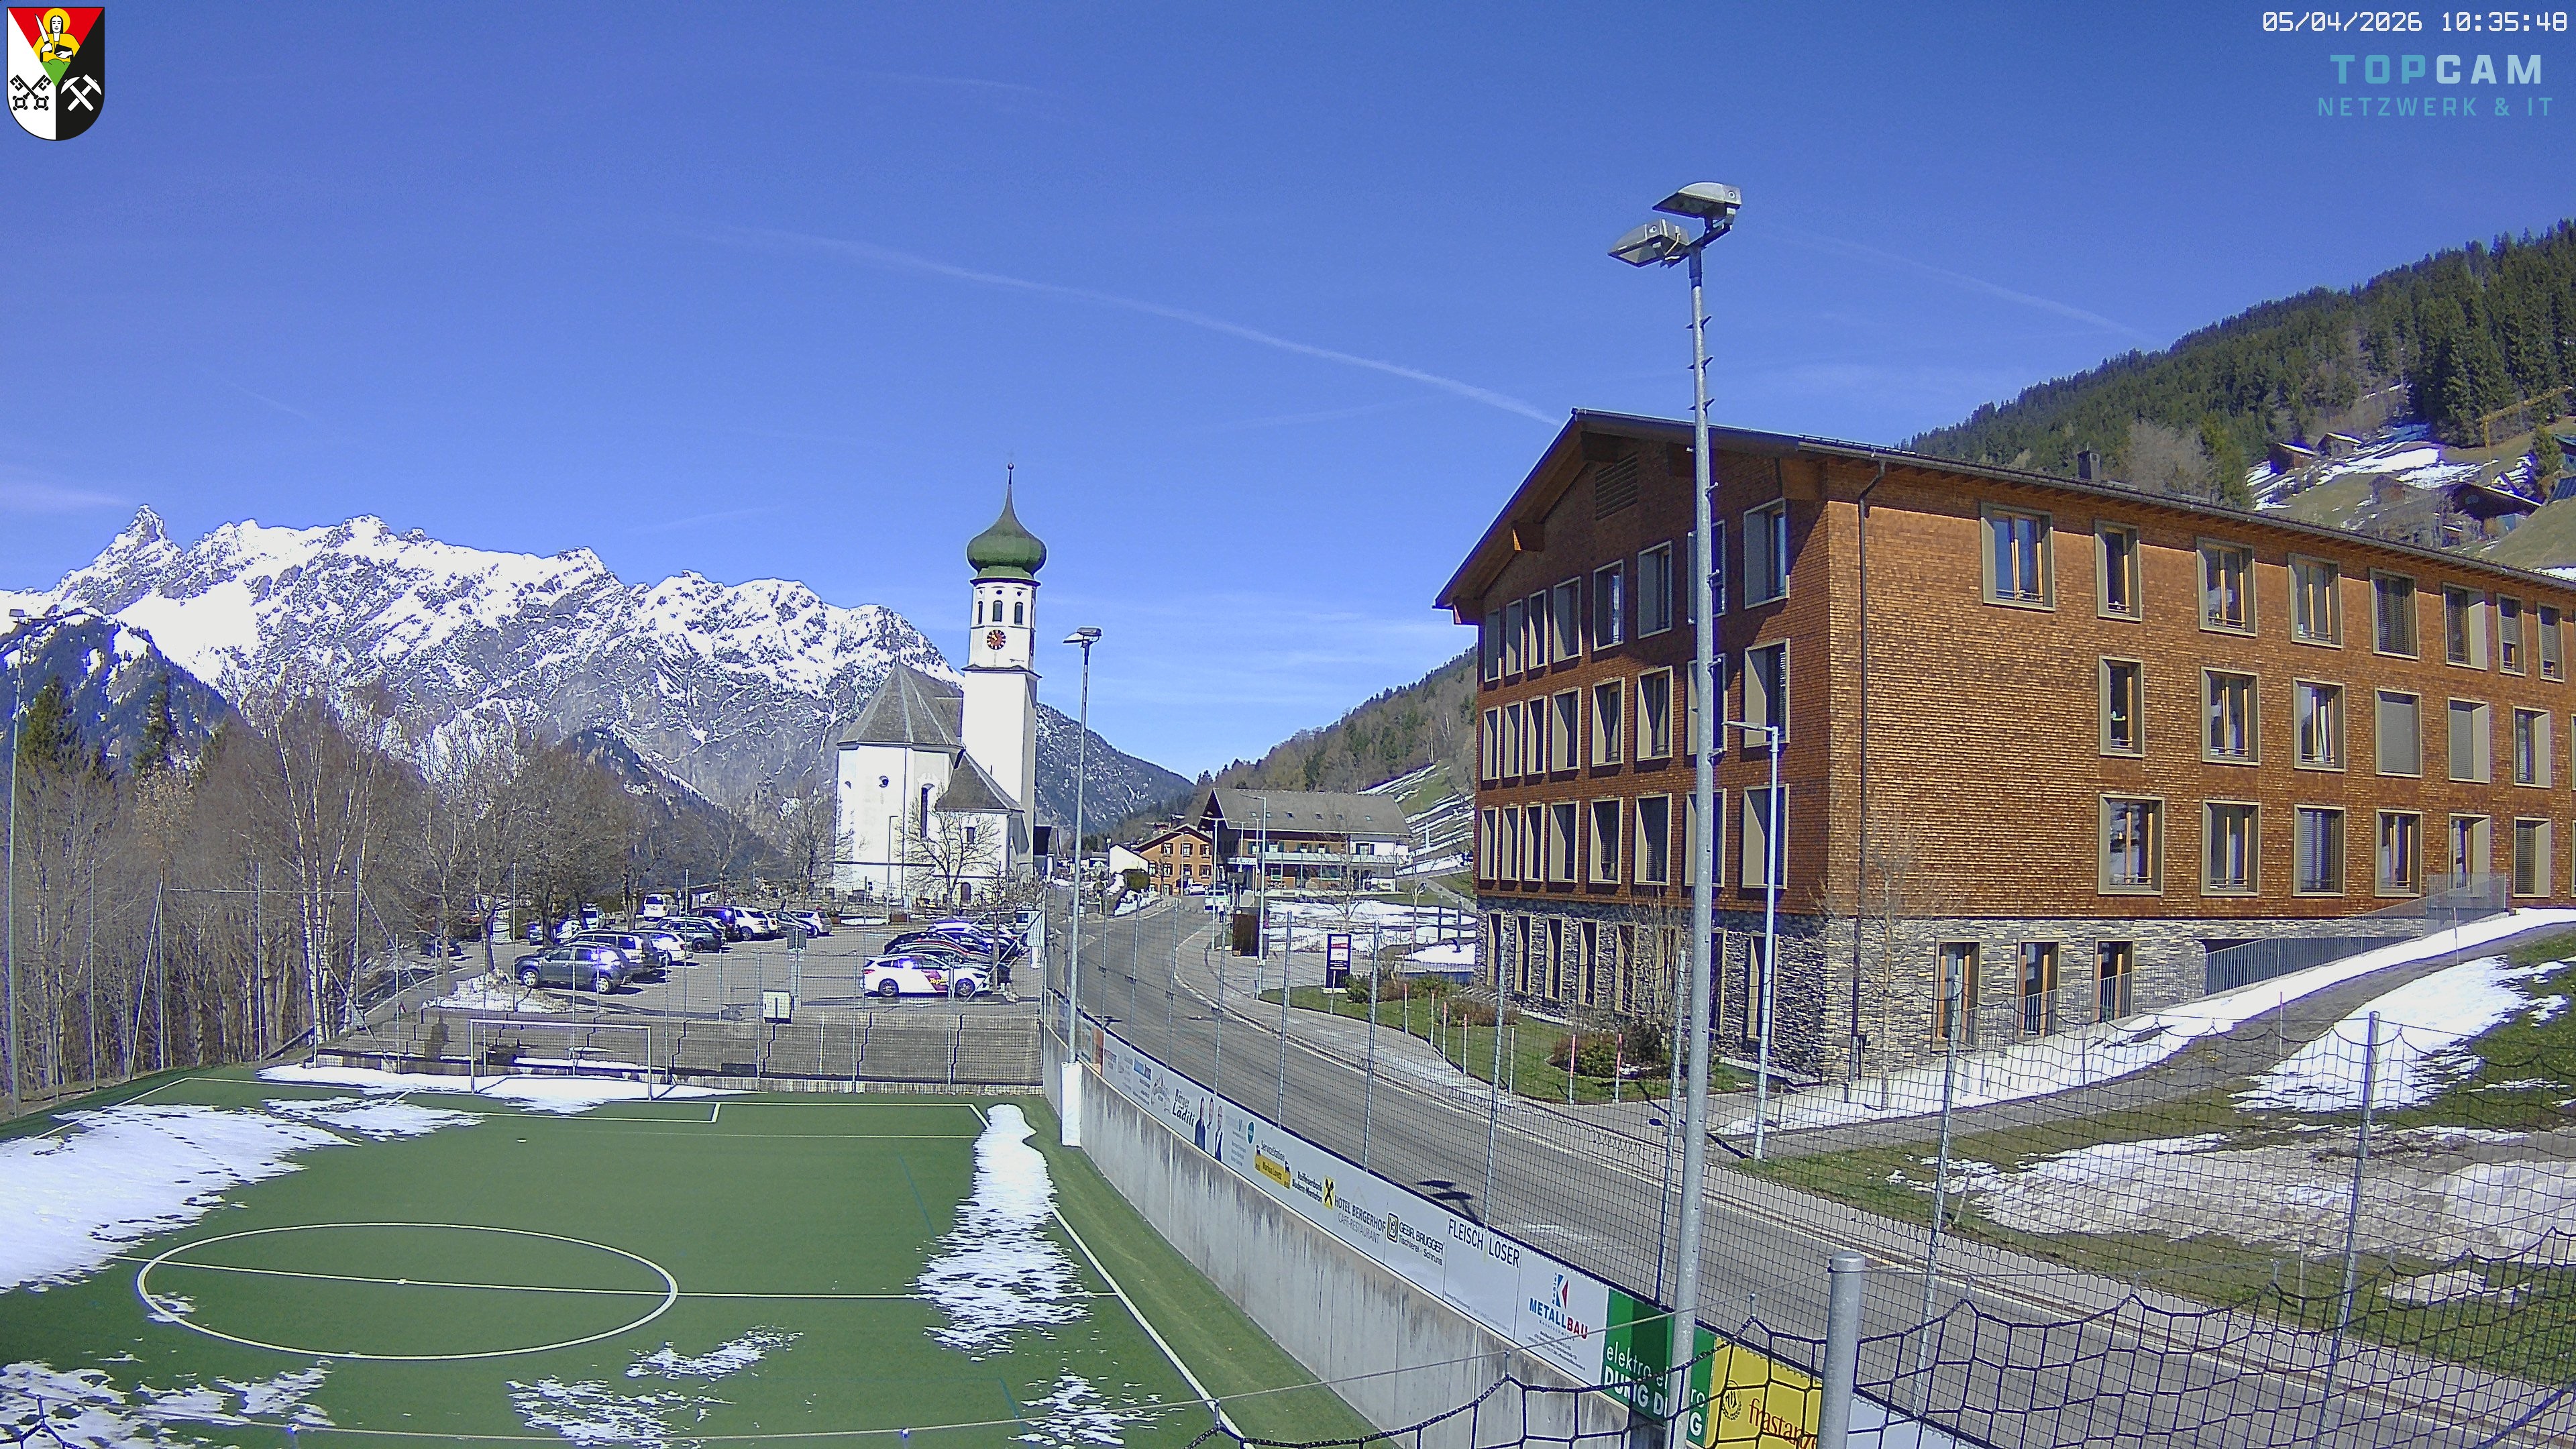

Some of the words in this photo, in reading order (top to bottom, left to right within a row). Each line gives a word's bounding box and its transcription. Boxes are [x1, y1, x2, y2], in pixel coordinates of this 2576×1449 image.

[1334, 1195, 1350, 1215] HOTEL
[1352, 1205, 1387, 1233] BERGERHOF
[1415, 1230, 1444, 1254] BRUGGER
[1448, 1218, 1485, 1251] FLEISCH
[1489, 1237, 1520, 1269] LOSER
[1529, 1297, 1589, 1340] METALLBAU
[1606, 1341, 1652, 1377] elektro
